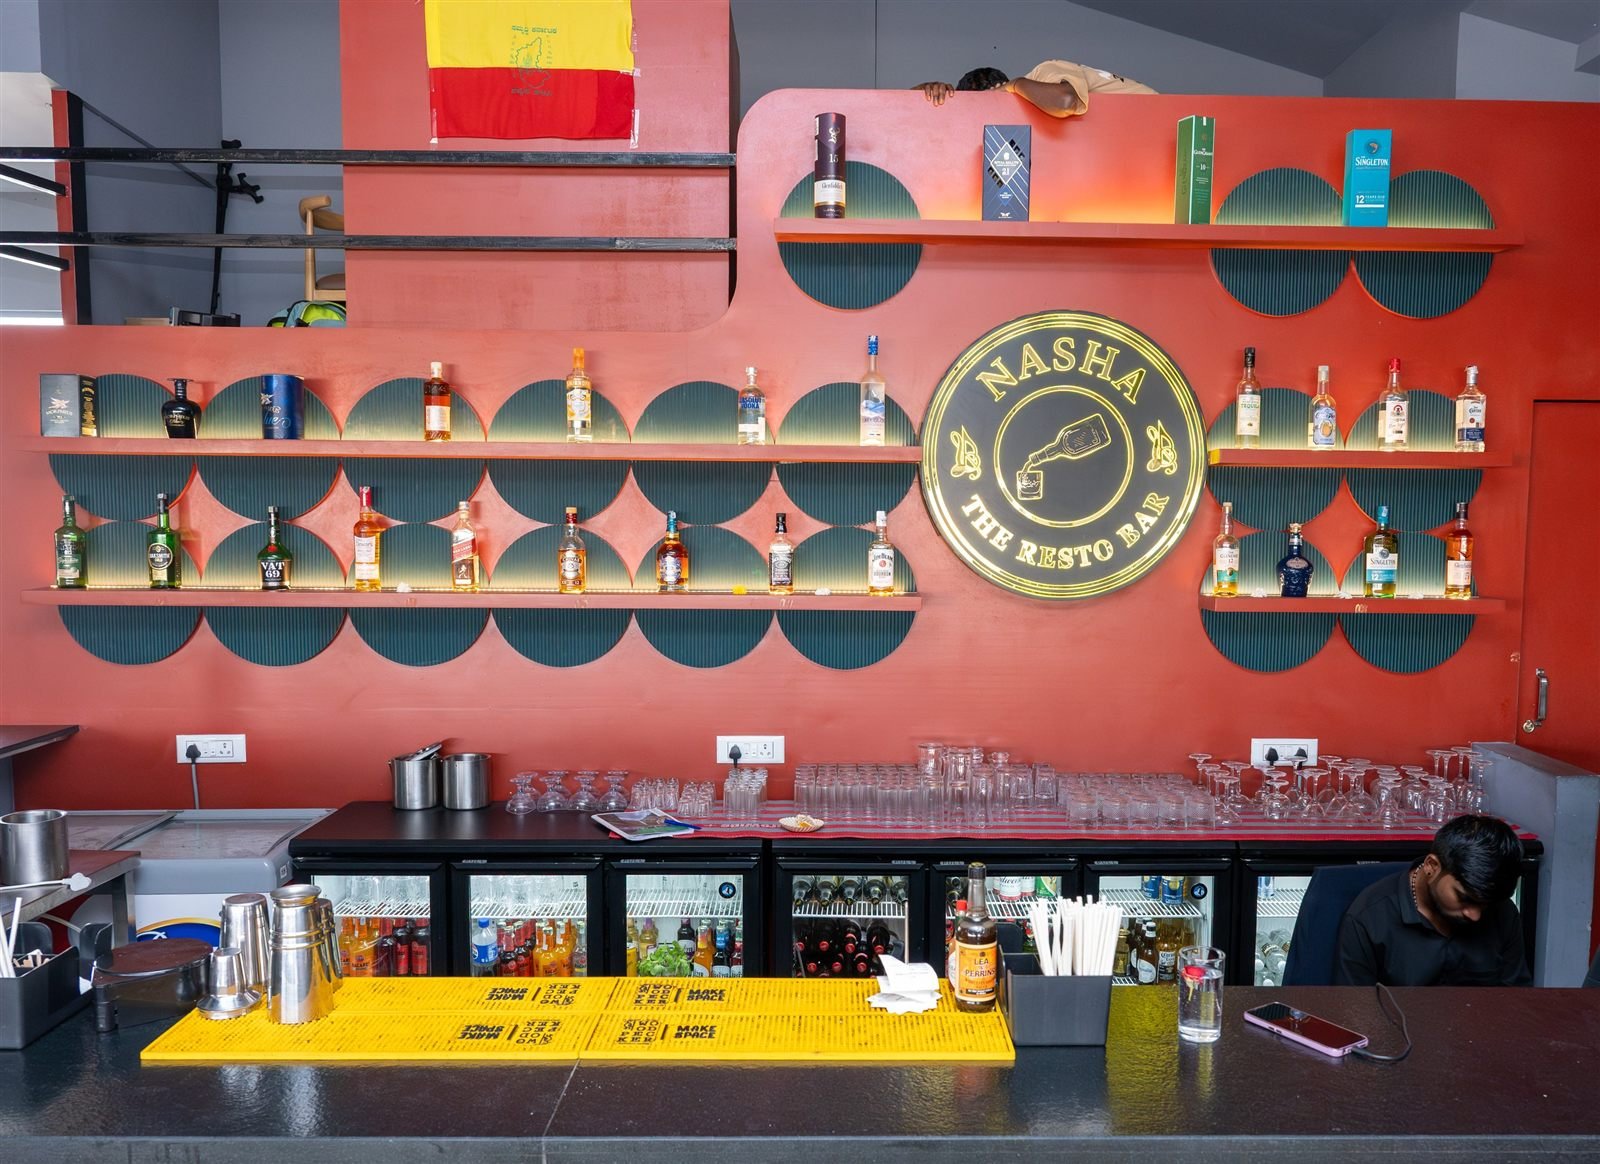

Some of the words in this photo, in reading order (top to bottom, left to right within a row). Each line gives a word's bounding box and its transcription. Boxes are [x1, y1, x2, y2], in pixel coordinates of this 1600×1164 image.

[1355, 194, 1365, 204] 12
[976, 337, 1146, 404] NASHA
[962, 493, 1014, 551] THE
[1016, 539, 1114, 569] RESTO
[1116, 492, 1170, 548] BAR
[261, 561, 285, 570] VAT
[265, 570, 280, 578] 69
[974, 958, 989, 966] LEA
[965, 969, 996, 977] PERRINS
[486, 993, 525, 1001] MAKE
[687, 994, 725, 1002] SPACE
[463, 1024, 505, 1032] SPACE
[458, 1031, 501, 1040] MAKE
[674, 1031, 717, 1039] SPACE
